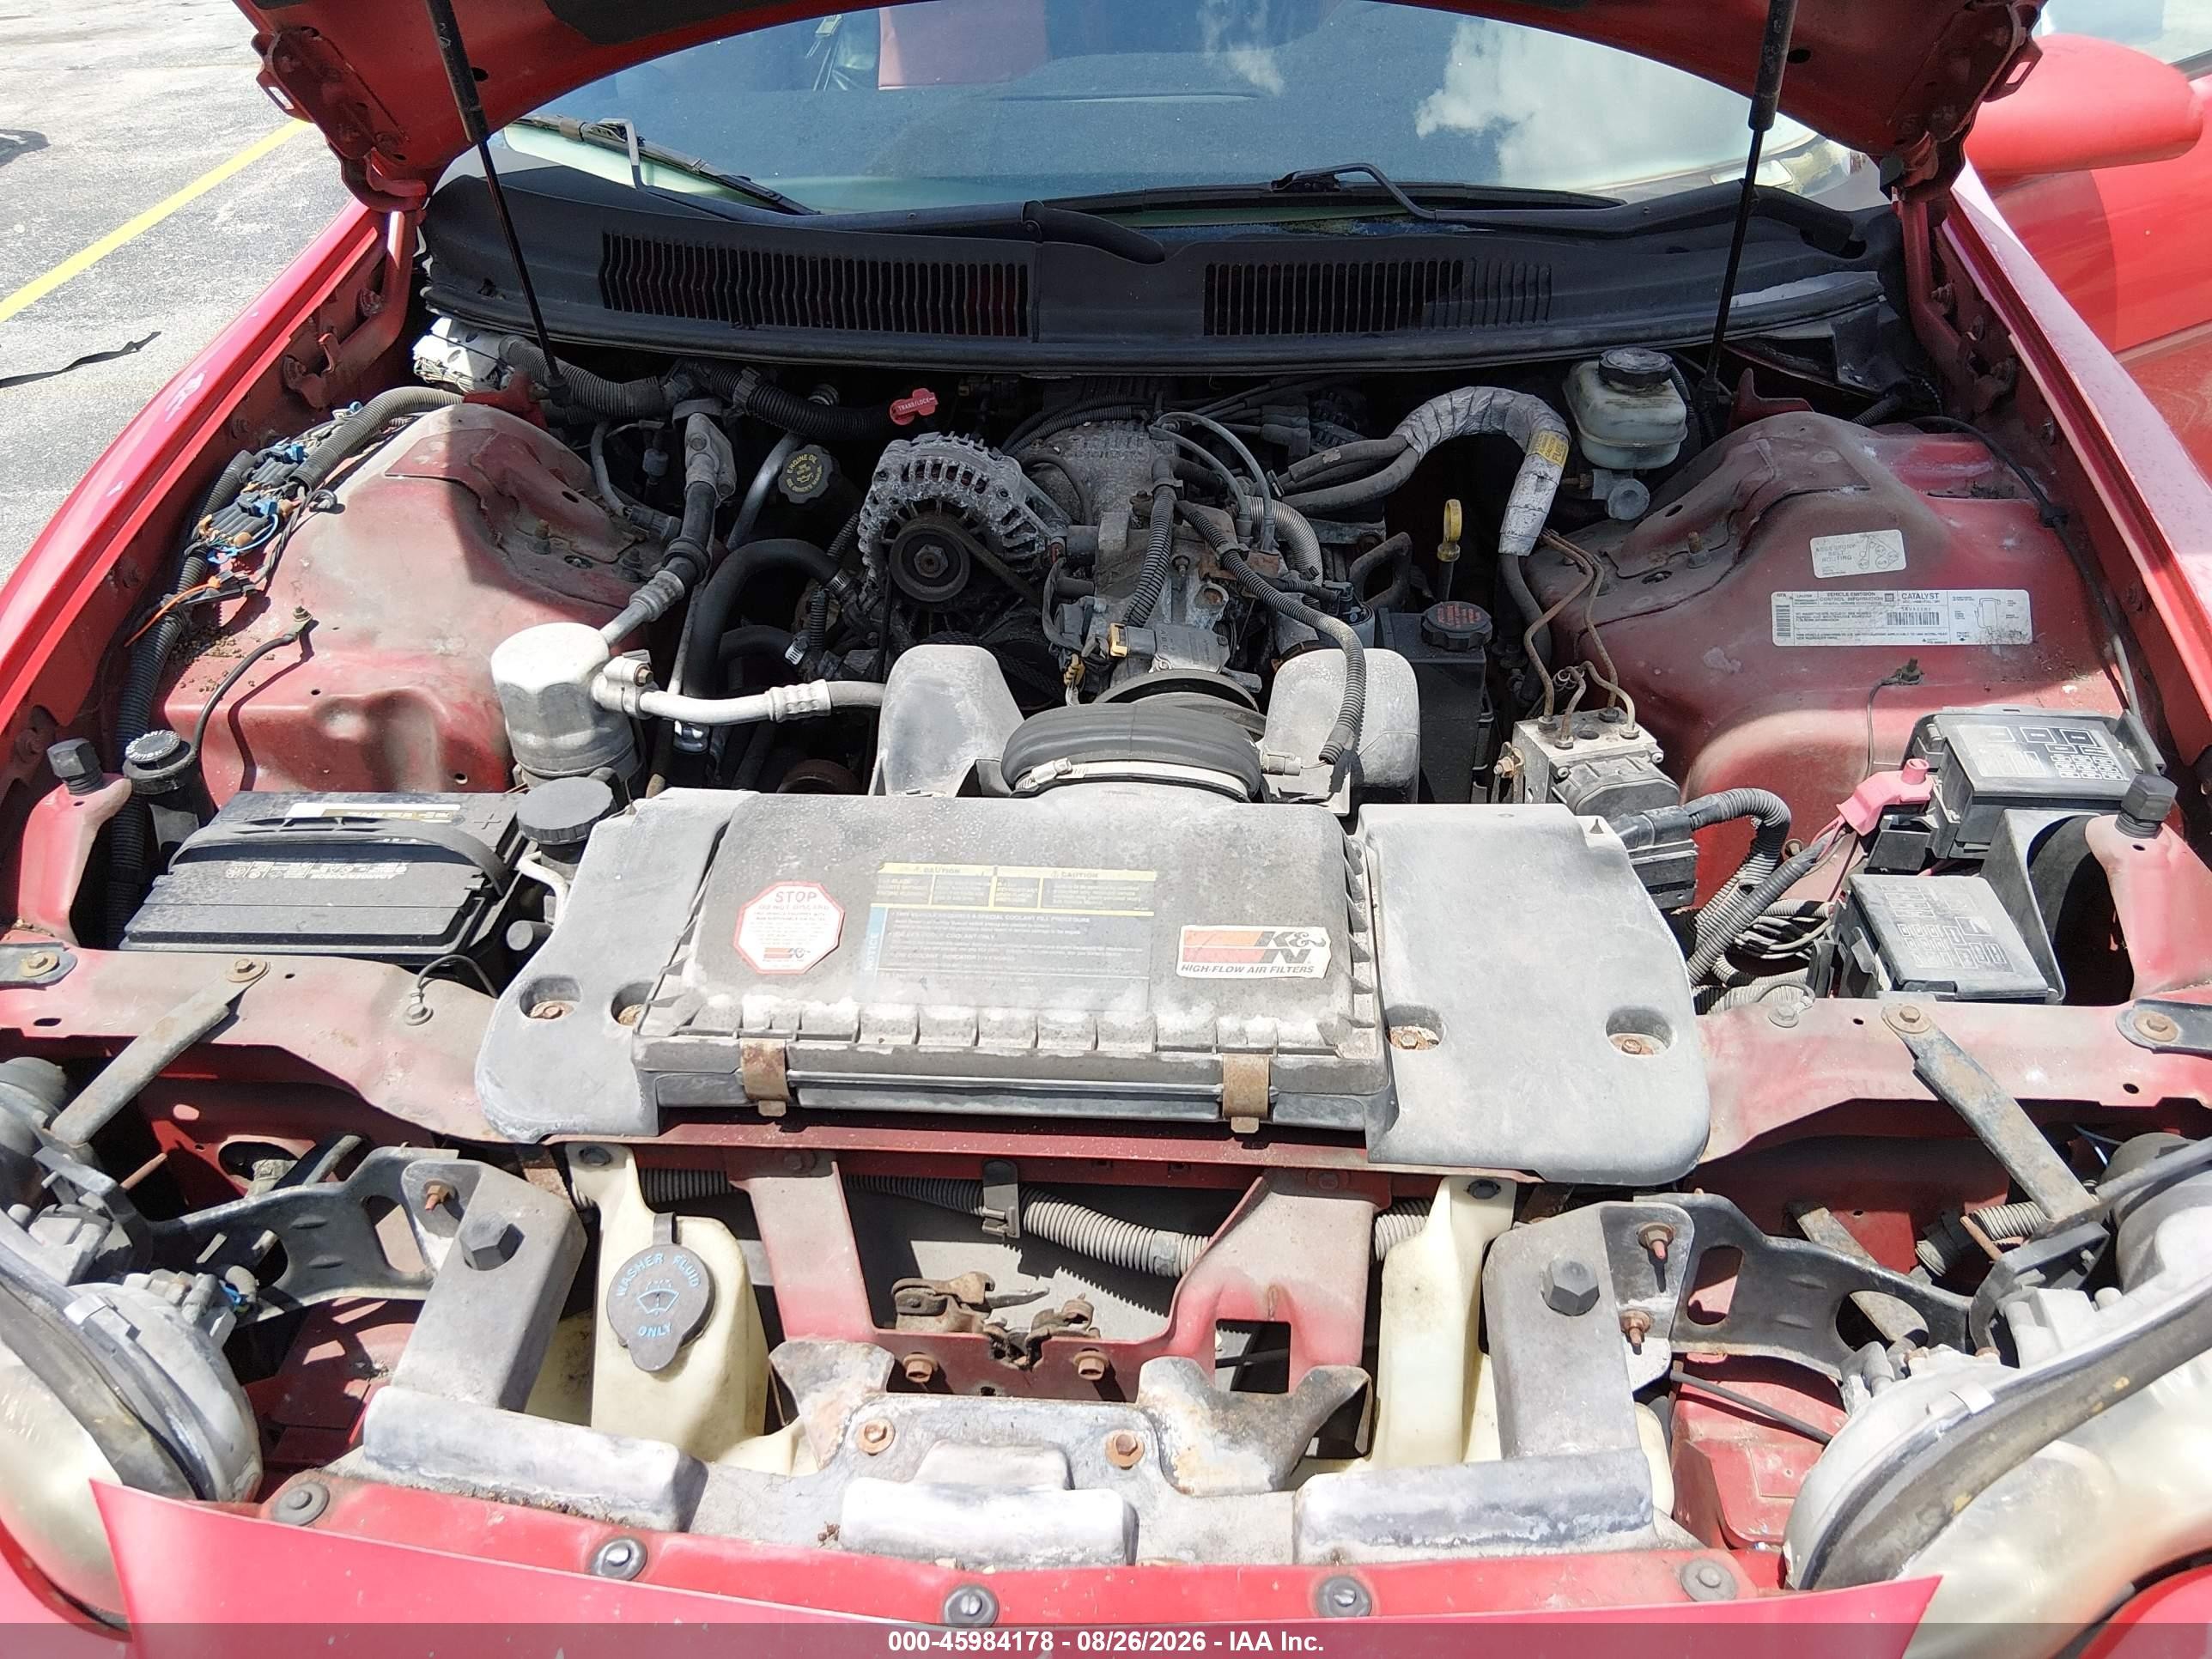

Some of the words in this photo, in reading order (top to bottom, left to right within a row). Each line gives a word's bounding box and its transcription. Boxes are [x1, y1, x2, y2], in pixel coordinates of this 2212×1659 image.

[775, 890, 817, 903] STOP
[1254, 930, 1327, 964] K&N
[1181, 963, 1245, 974] HIGH-FLOW
[1269, 965, 1315, 974] FILTERS
[616, 1251, 665, 1297] WASHER
[672, 1254, 702, 1288] FLUID
[638, 1322, 672, 1339] ONLY
